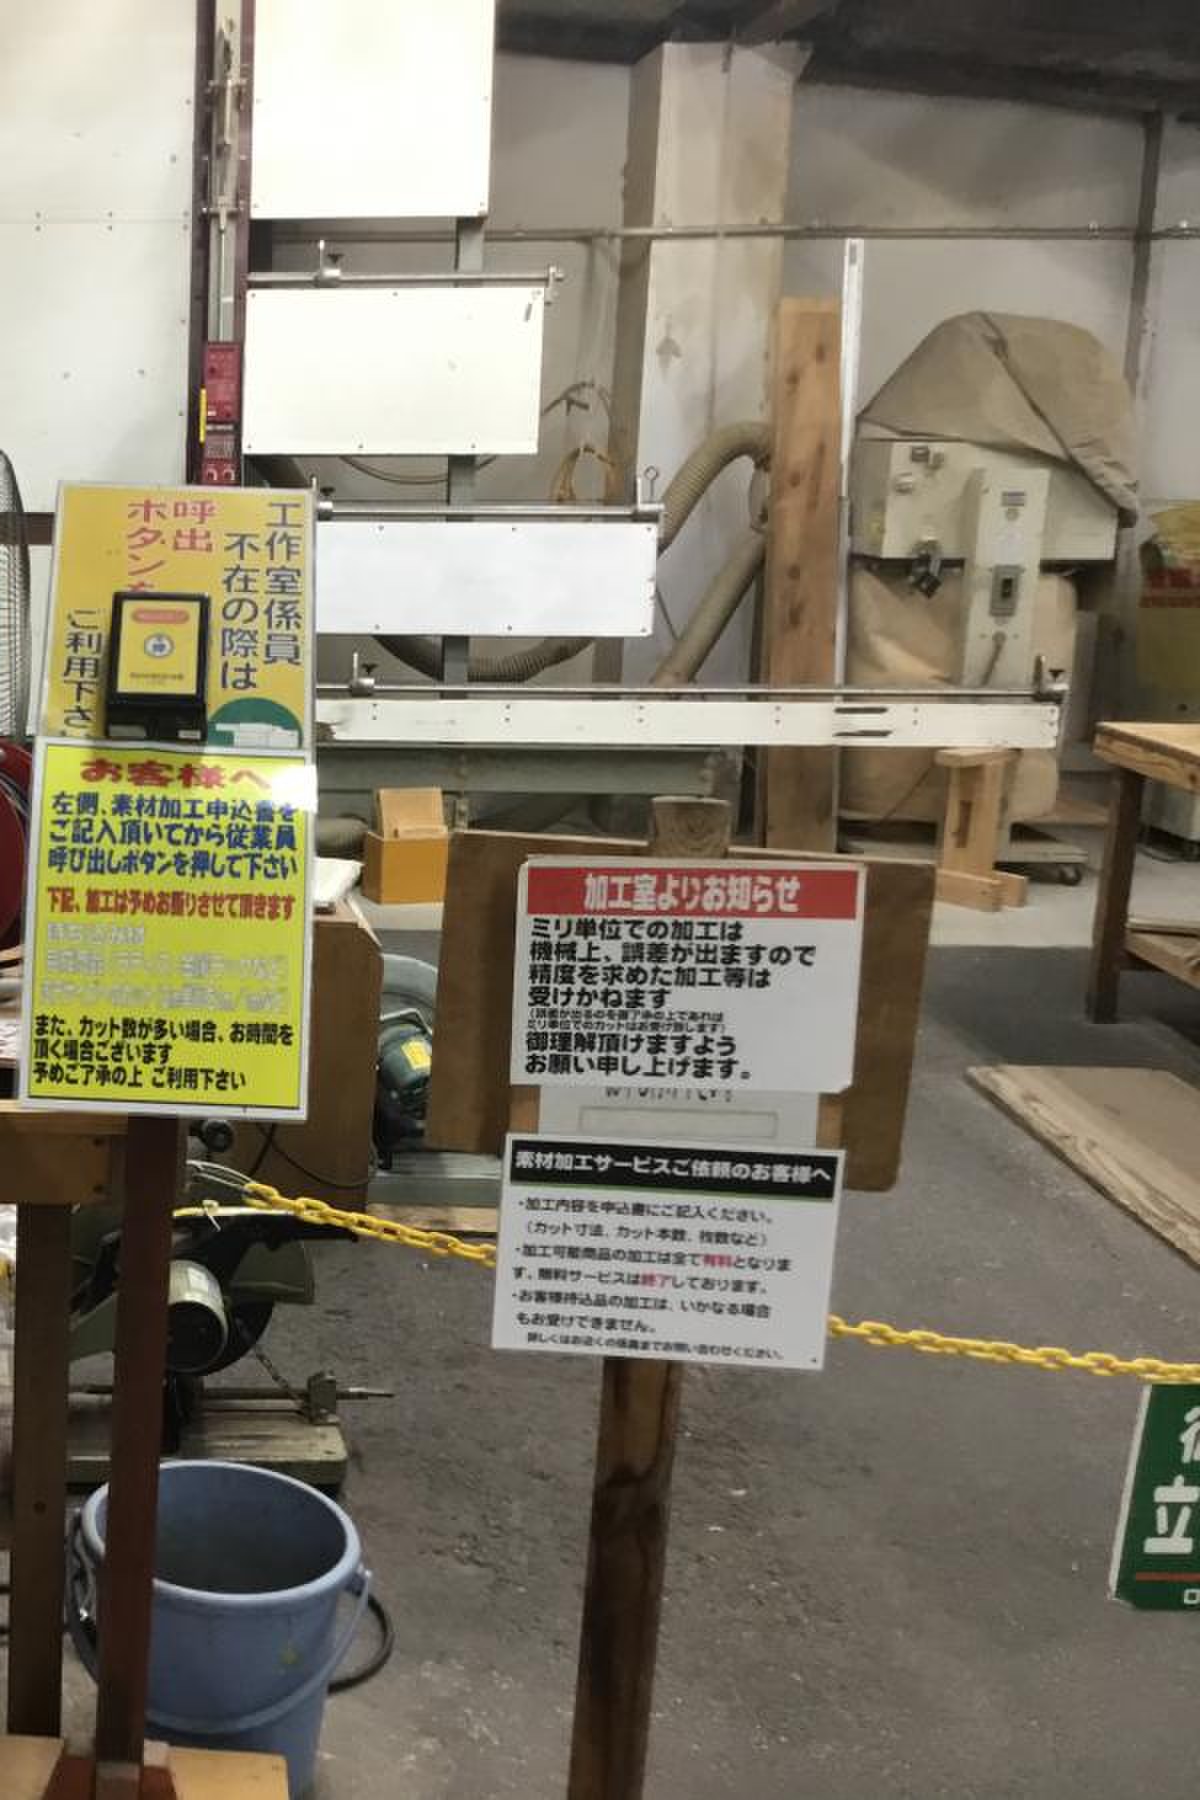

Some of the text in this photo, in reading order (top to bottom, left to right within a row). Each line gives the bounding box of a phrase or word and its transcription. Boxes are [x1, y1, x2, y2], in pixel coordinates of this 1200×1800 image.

[173, 500, 216, 553] 呼出
[262, 502, 303, 666] 工作室係員
[220, 533, 260, 690] 不在の際は
[80, 758, 271, 789] お客様へ
[49, 819, 297, 850] ご記入頂いてから従業員
[48, 849, 297, 880] 呼び出しボタンを押して下さい
[583, 873, 801, 914] 加工室よりお知らせ
[530, 918, 744, 942] ミリ単位での加工は
[529, 942, 817, 967] 機械上、誤差が出ますので
[528, 965, 771, 988] 精度を求めた加工等は
[528, 986, 671, 1009] 受けかねます
[35, 1015, 294, 1046] また、カット数が多い場合、お時間を
[525, 1032, 737, 1057] 御理解頂けますよう
[525, 1054, 750, 1080] お願い申し上げます。
[515, 1150, 833, 1184] 素材加工サービスご依頼のお客様へ
